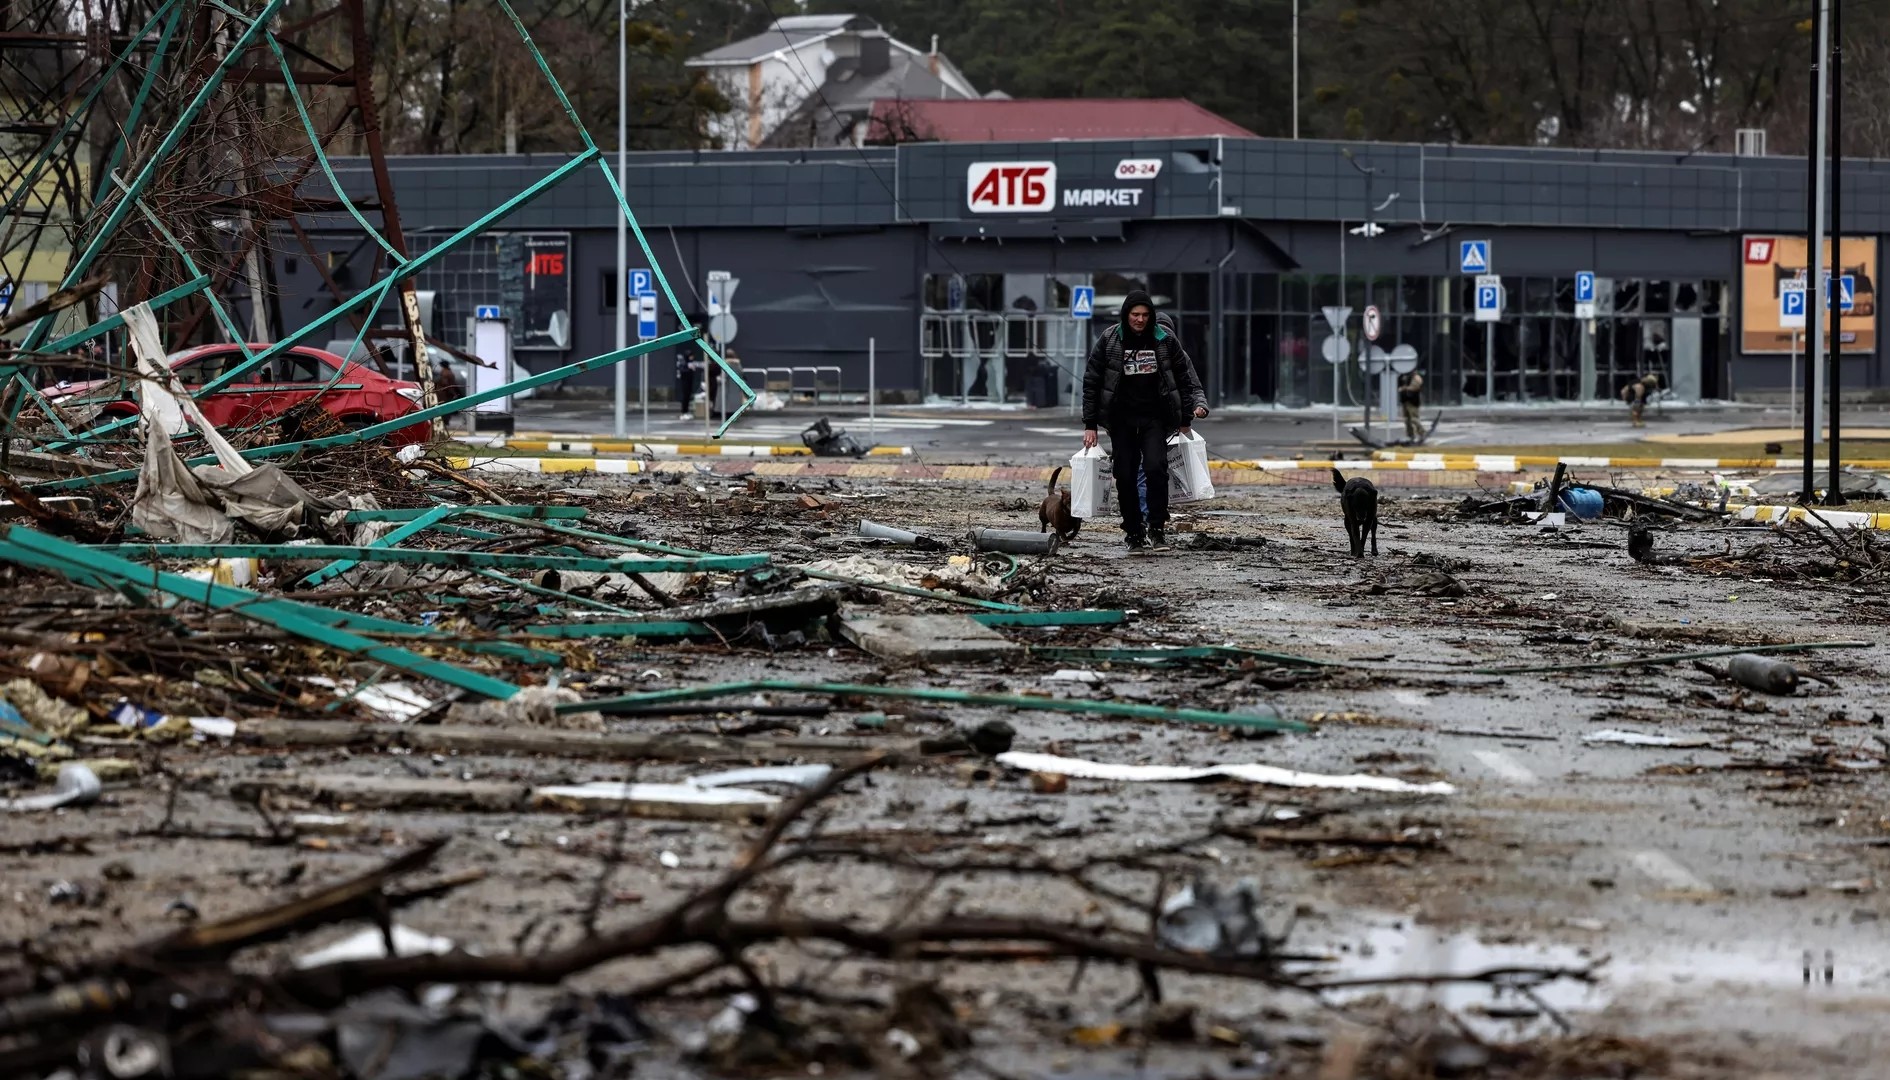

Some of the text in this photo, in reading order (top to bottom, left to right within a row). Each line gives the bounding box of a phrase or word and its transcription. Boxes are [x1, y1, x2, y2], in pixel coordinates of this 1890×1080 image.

[1119, 164, 1156, 175] 00-24
[972, 167, 1050, 206] АТБ
[1063, 188, 1143, 206] МАРКЕТ
[525, 252, 565, 275] АТБ
[634, 273, 646, 294] P
[1581, 276, 1590, 297] P
[1483, 289, 1493, 306] P
[1789, 294, 1799, 313] P
